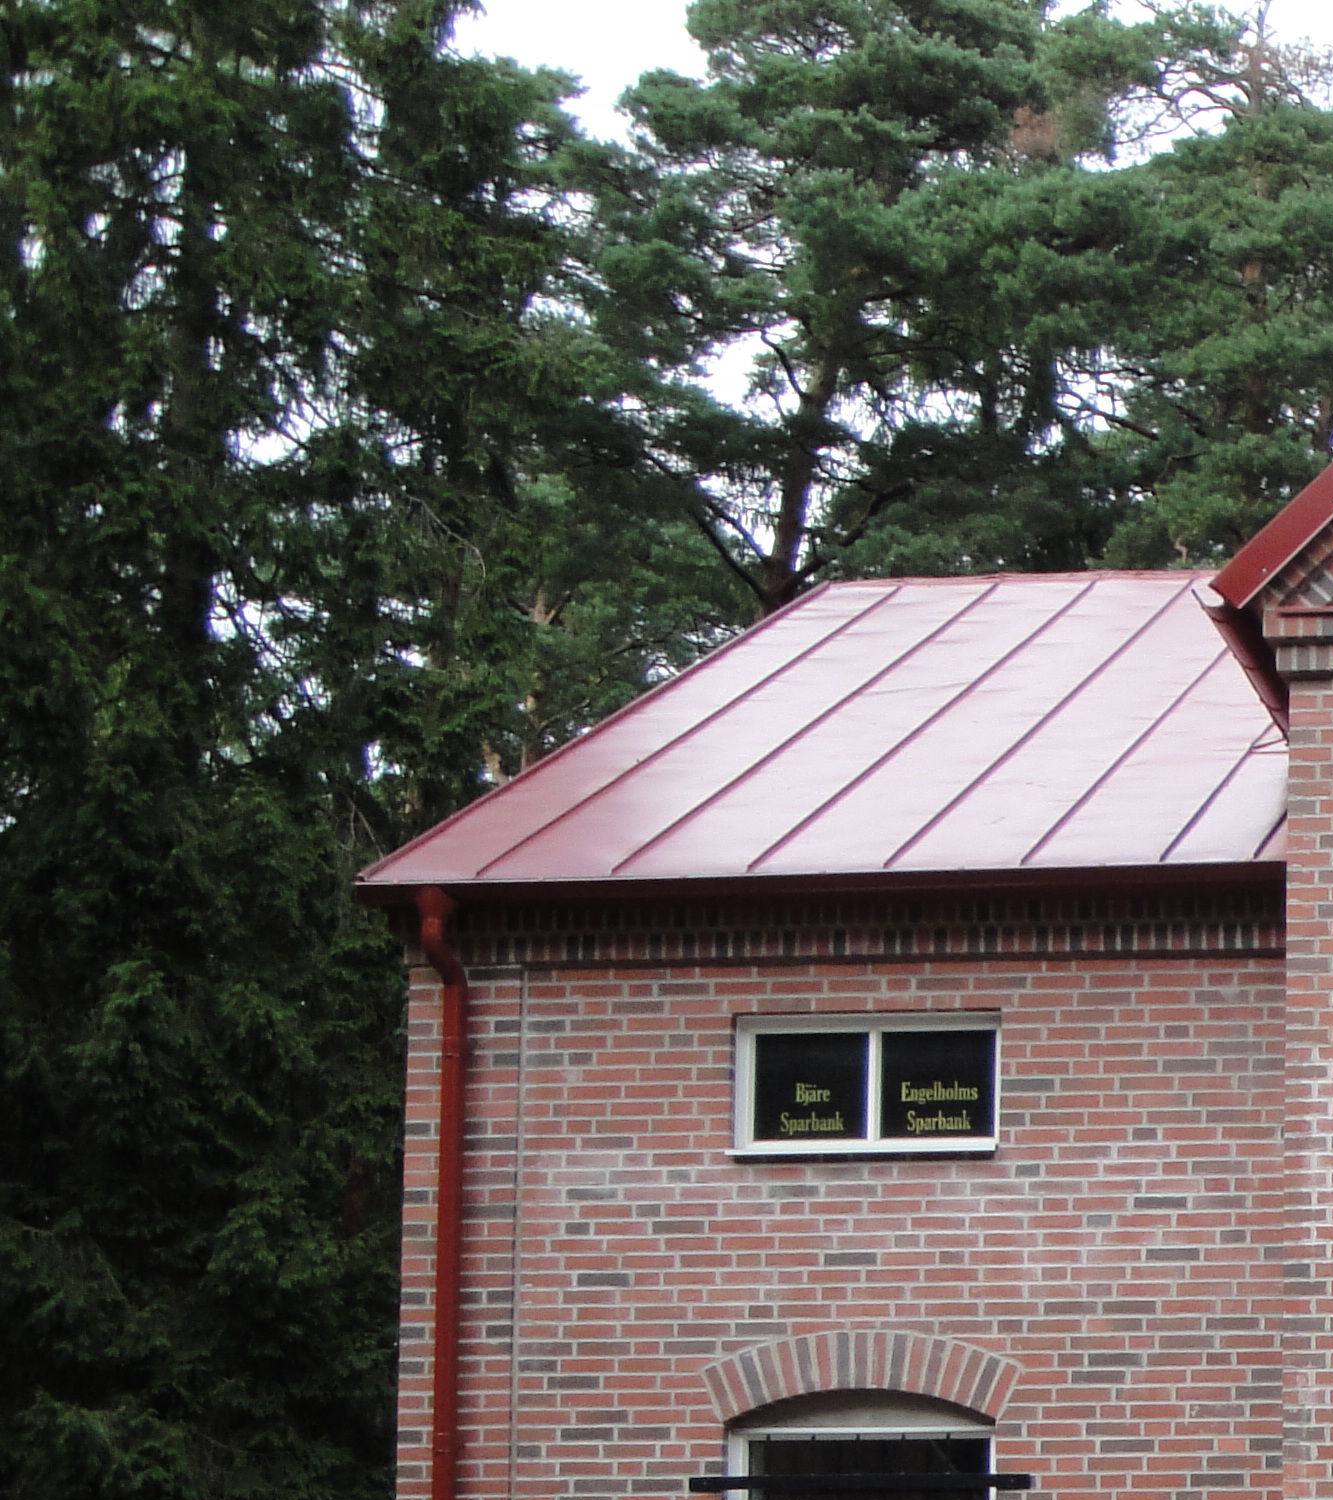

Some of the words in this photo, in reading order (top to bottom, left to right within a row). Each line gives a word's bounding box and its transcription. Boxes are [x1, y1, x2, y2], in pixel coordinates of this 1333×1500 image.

[795, 1083, 831, 1106] Bjäre
[901, 1081, 979, 1104] Engelholms
[780, 1111, 844, 1136] Sparbank
[907, 1109, 971, 1135] Sparbank
